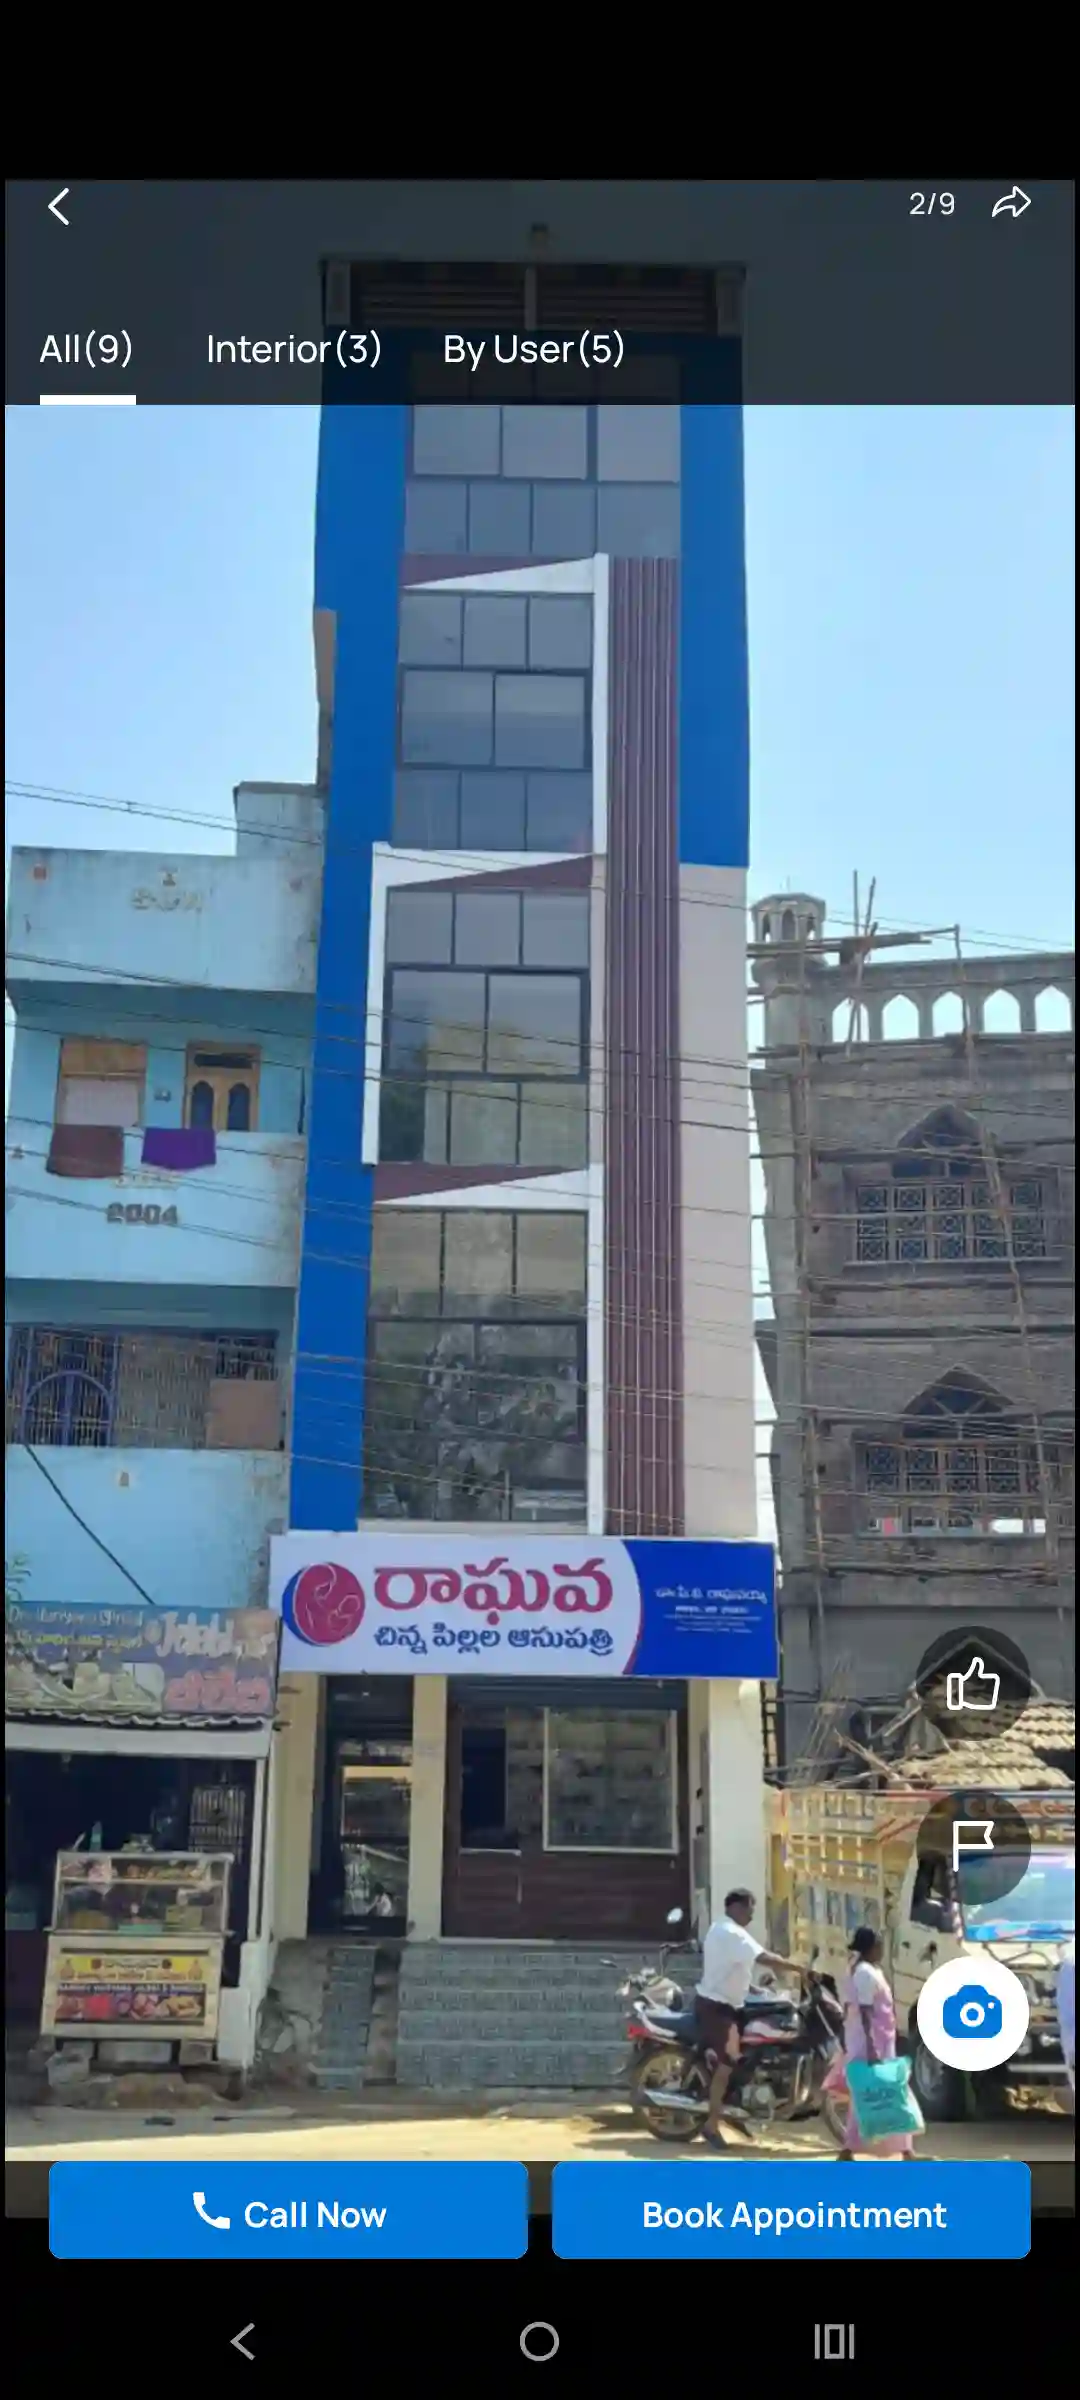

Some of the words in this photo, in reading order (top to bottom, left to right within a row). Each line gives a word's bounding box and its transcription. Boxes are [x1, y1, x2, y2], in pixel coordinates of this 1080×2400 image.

[106, 1202, 179, 1226] 2004
[374, 1557, 613, 1626] రాఘవ
[373, 1623, 428, 1655] చిన్న
[432, 1621, 501, 1655] పిల్లల
[507, 1625, 614, 1657] ఆసుపత్రి
